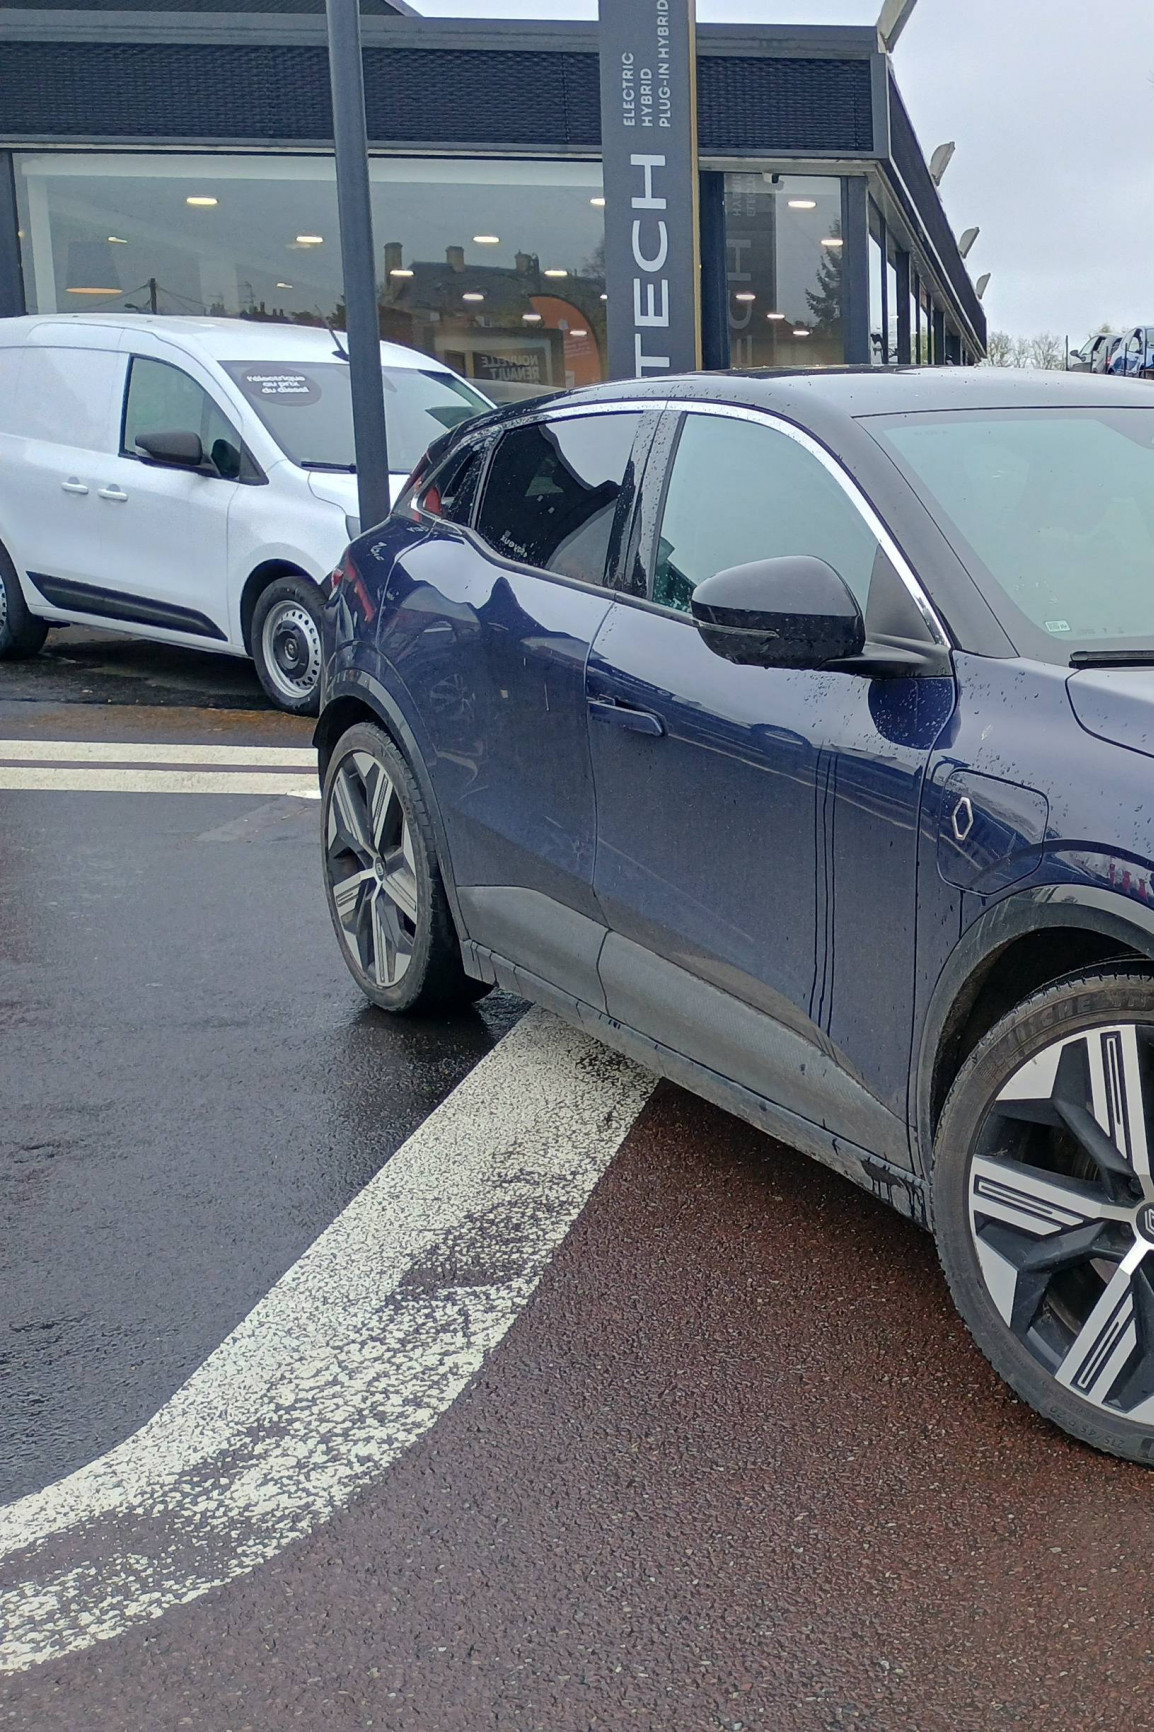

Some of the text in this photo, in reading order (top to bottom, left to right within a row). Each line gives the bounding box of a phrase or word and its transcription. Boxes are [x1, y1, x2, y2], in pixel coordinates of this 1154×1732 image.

[622, 51, 635, 127] ELECTRIC
[641, 67, 653, 127] HYBRID
[656, 0, 671, 128] PLUG-IN HYBRID
[630, 154, 670, 378] TECH
